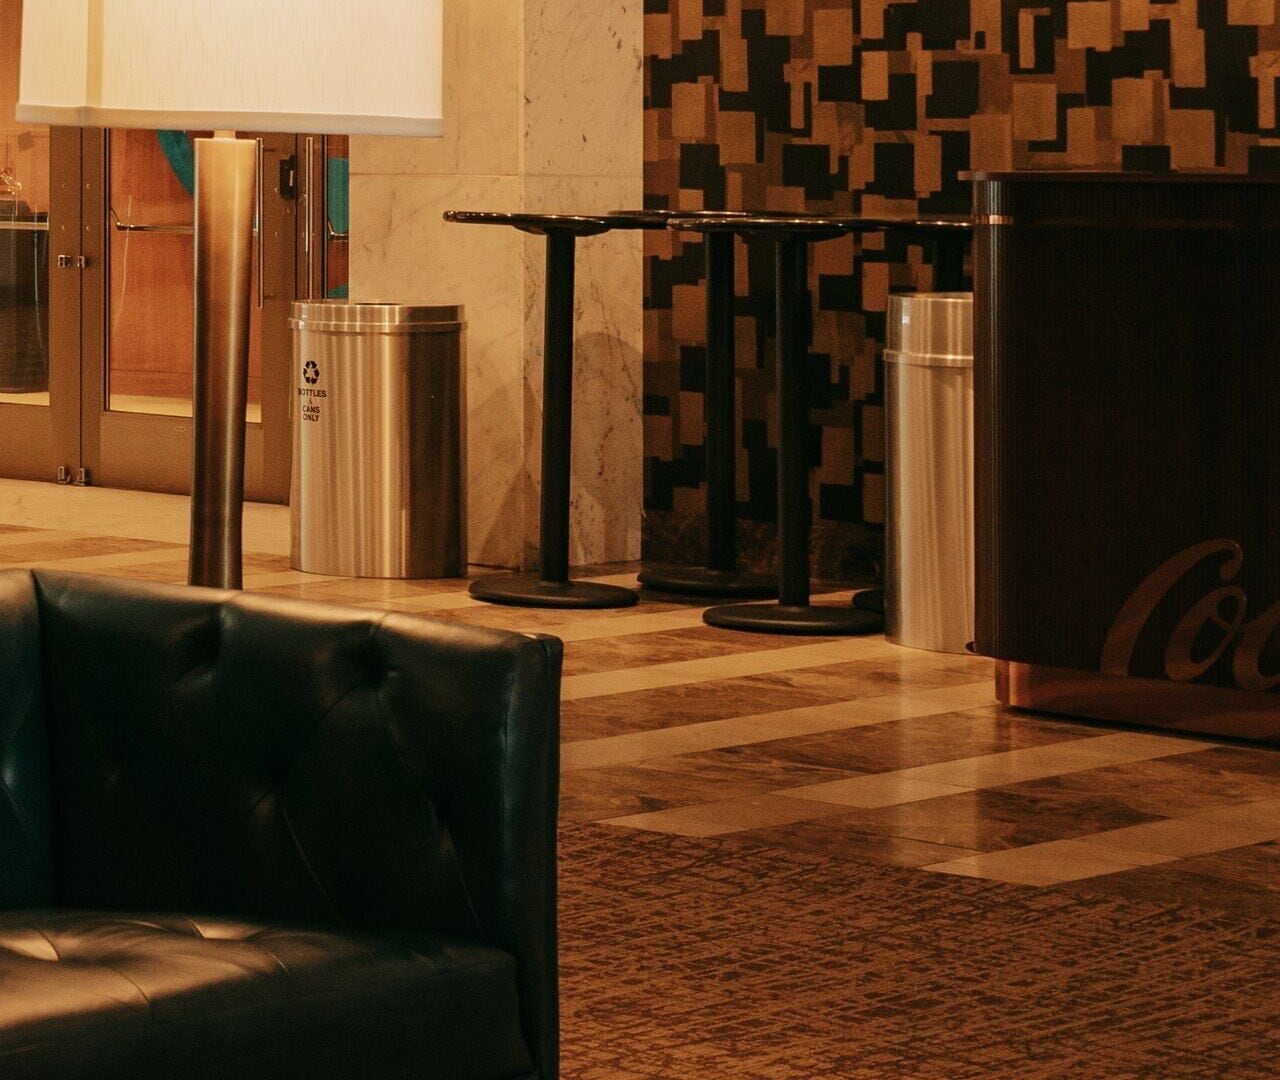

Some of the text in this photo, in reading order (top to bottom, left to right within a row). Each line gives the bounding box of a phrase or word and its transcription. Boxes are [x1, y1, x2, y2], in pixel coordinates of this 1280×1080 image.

[298, 388, 327, 398] BOTTLES
[302, 405, 321, 414] CANS
[302, 414, 320, 422] ONLY
